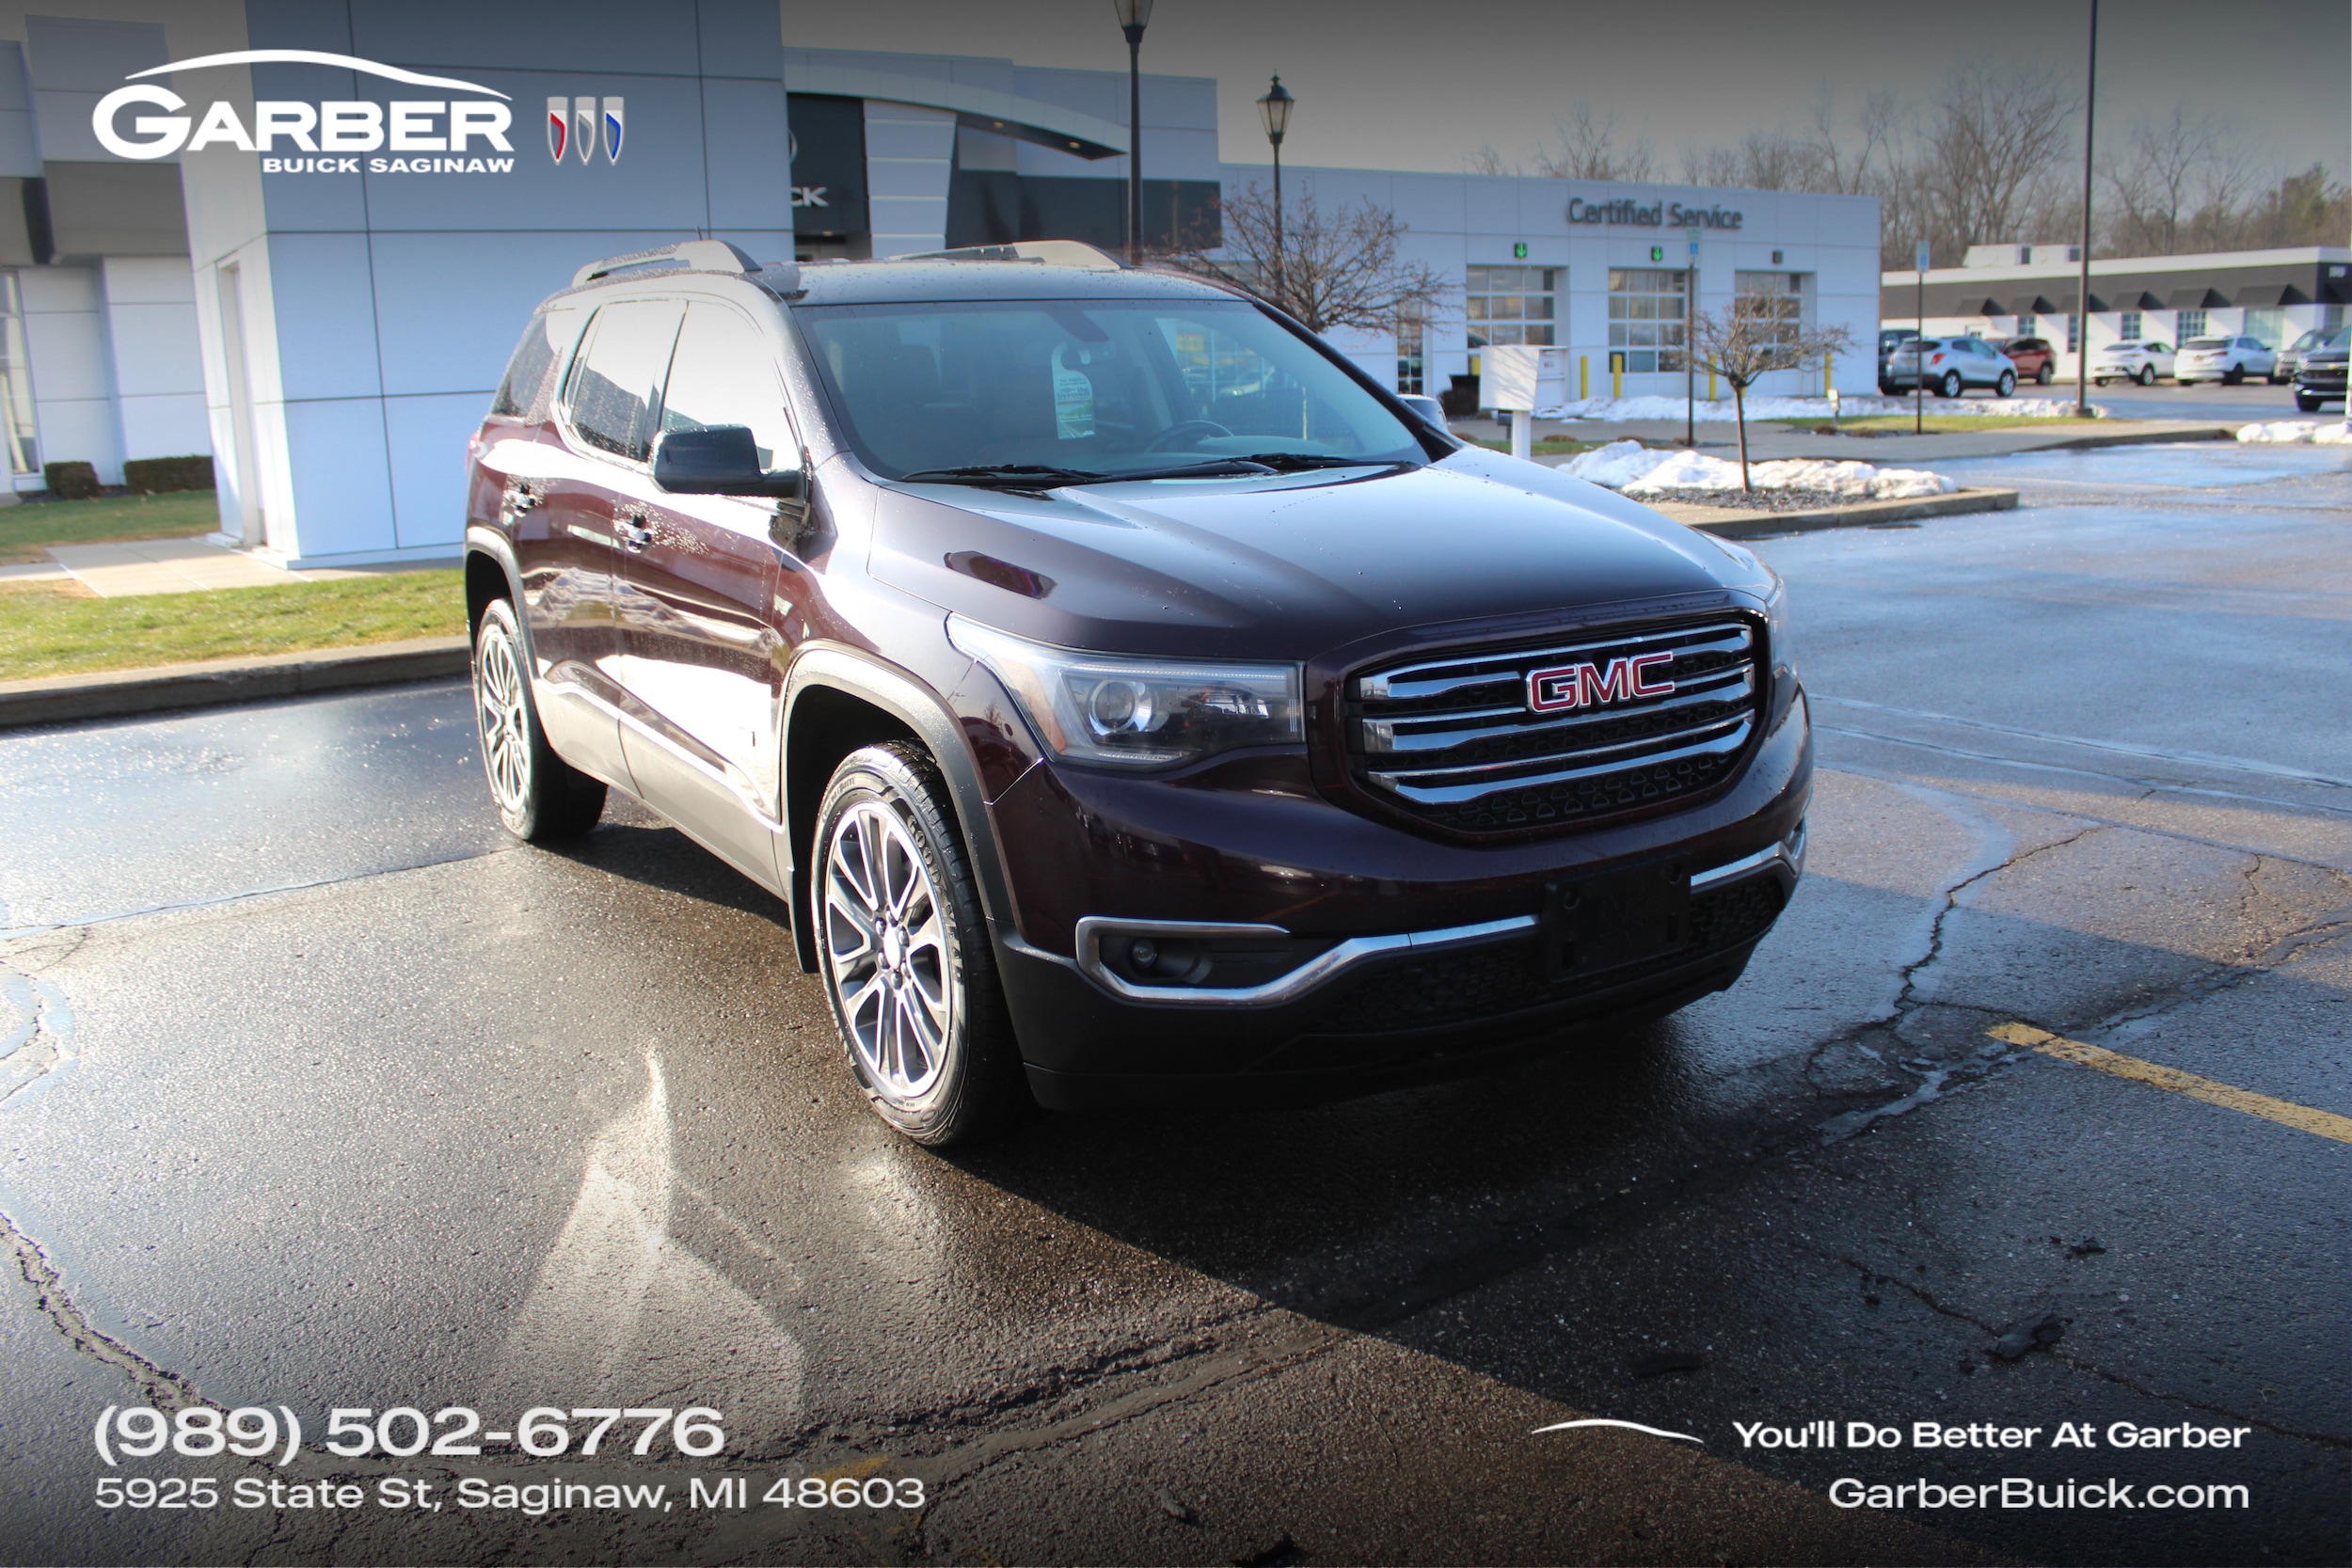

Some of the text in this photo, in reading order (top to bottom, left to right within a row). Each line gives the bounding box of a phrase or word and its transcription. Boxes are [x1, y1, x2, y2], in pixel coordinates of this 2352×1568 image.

[1567, 197, 1743, 230] Certified Service
[1526, 650, 1676, 715] GMC
